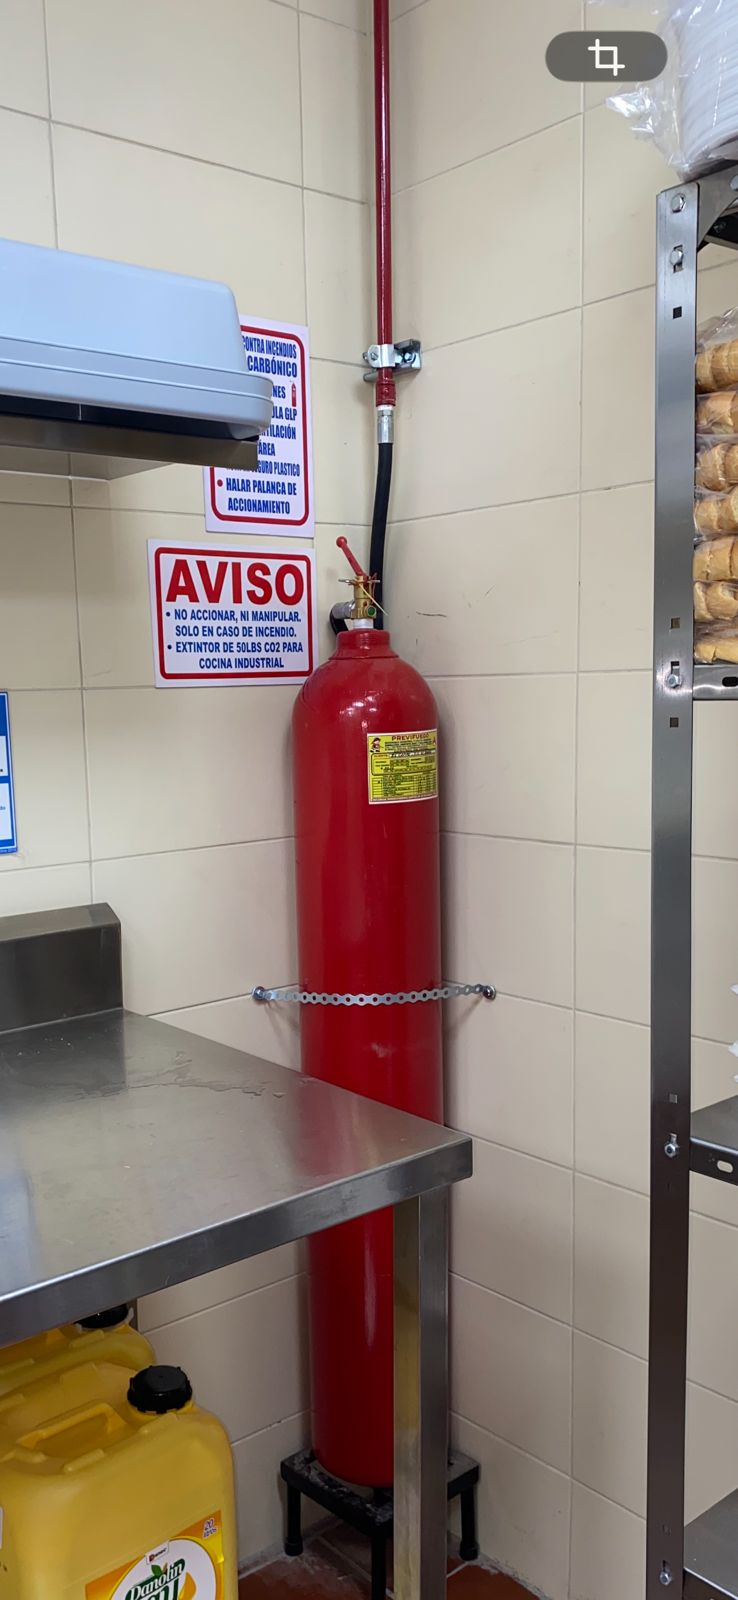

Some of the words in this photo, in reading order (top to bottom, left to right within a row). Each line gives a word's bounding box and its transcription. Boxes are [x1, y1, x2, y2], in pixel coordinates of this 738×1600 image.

[266, 339, 297, 360] INCENDIOS
[247, 355, 297, 378] CARBÓNICO
[272, 385, 286, 399] NES
[285, 407, 298, 421] GLP
[258, 440, 276, 456] ÁREA
[273, 461, 300, 477] PLASTICO
[226, 477, 251, 493] HALAR
[252, 479, 286, 496] PALANCA
[287, 482, 297, 496] DE
[228, 497, 290, 515] ACCIONAMIENTO
[165, 559, 304, 606] AVISO
[174, 609, 188, 621] NO
[190, 609, 238, 623] ACCIONAR,
[240, 610, 249, 622] NI
[251, 611, 302, 622] MANIPULAR.
[175, 625, 199, 637] SOLO
[202, 626, 214, 637] EN
[216, 626, 239, 638] CASO
[242, 626, 253, 637] DE
[255, 626, 297, 638] INCENDIO.
[175, 641, 220, 653] EXTINTOR
[222, 641, 234, 653] DE
[236, 641, 262, 653] 50LBS
[264, 641, 281, 653] CO2
[282, 641, 304, 653] PARA
[199, 658, 233, 669] COCINA
[234, 657, 285, 669] INDUSTRIAL
